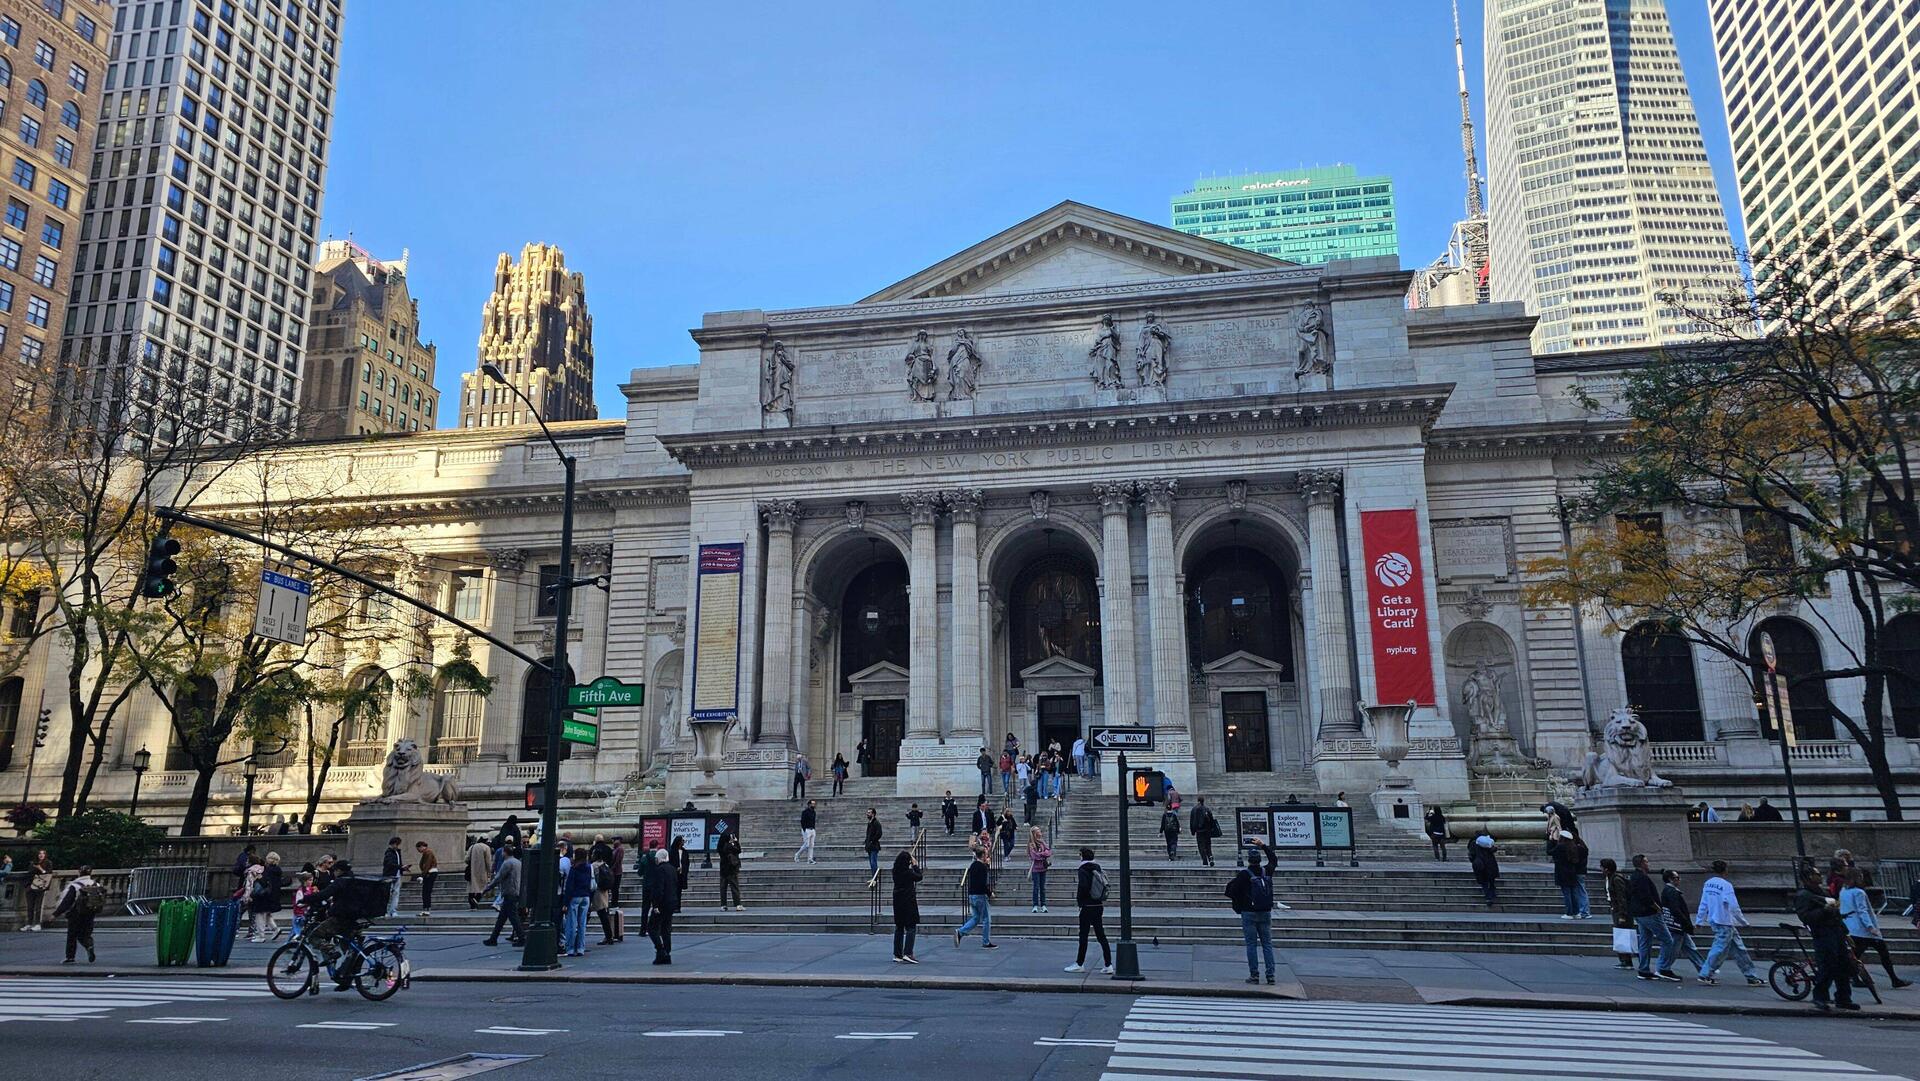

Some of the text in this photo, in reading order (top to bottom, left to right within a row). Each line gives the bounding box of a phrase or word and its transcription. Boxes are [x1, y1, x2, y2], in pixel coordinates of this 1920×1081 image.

[1242, 178, 1310, 191] salesforce
[1173, 318, 1282, 335] THE TILDEN TRUST
[985, 341, 1002, 350] THE
[1045, 334, 1086, 346] LIBRARY
[805, 354, 822, 362] THE
[830, 352, 858, 361] ASTOR
[869, 459, 906, 474] THE
[920, 455, 966, 471] NEW
[982, 451, 1031, 467] YORK
[1047, 447, 1114, 463] PUBLIC
[1131, 440, 1216, 458] LIBRARY
[274, 576, 301, 590] BUS LANES
[1382, 596, 1412, 604] Get a
[1377, 607, 1418, 618] Library
[262, 616, 276, 626] BUSES
[1384, 618, 1414, 628] Card!
[287, 623, 300, 632] BUSES
[1386, 646, 1417, 655] nypl.org
[579, 690, 631, 702] Fifth Ave
[1101, 734, 1143, 742] ONE WAY
